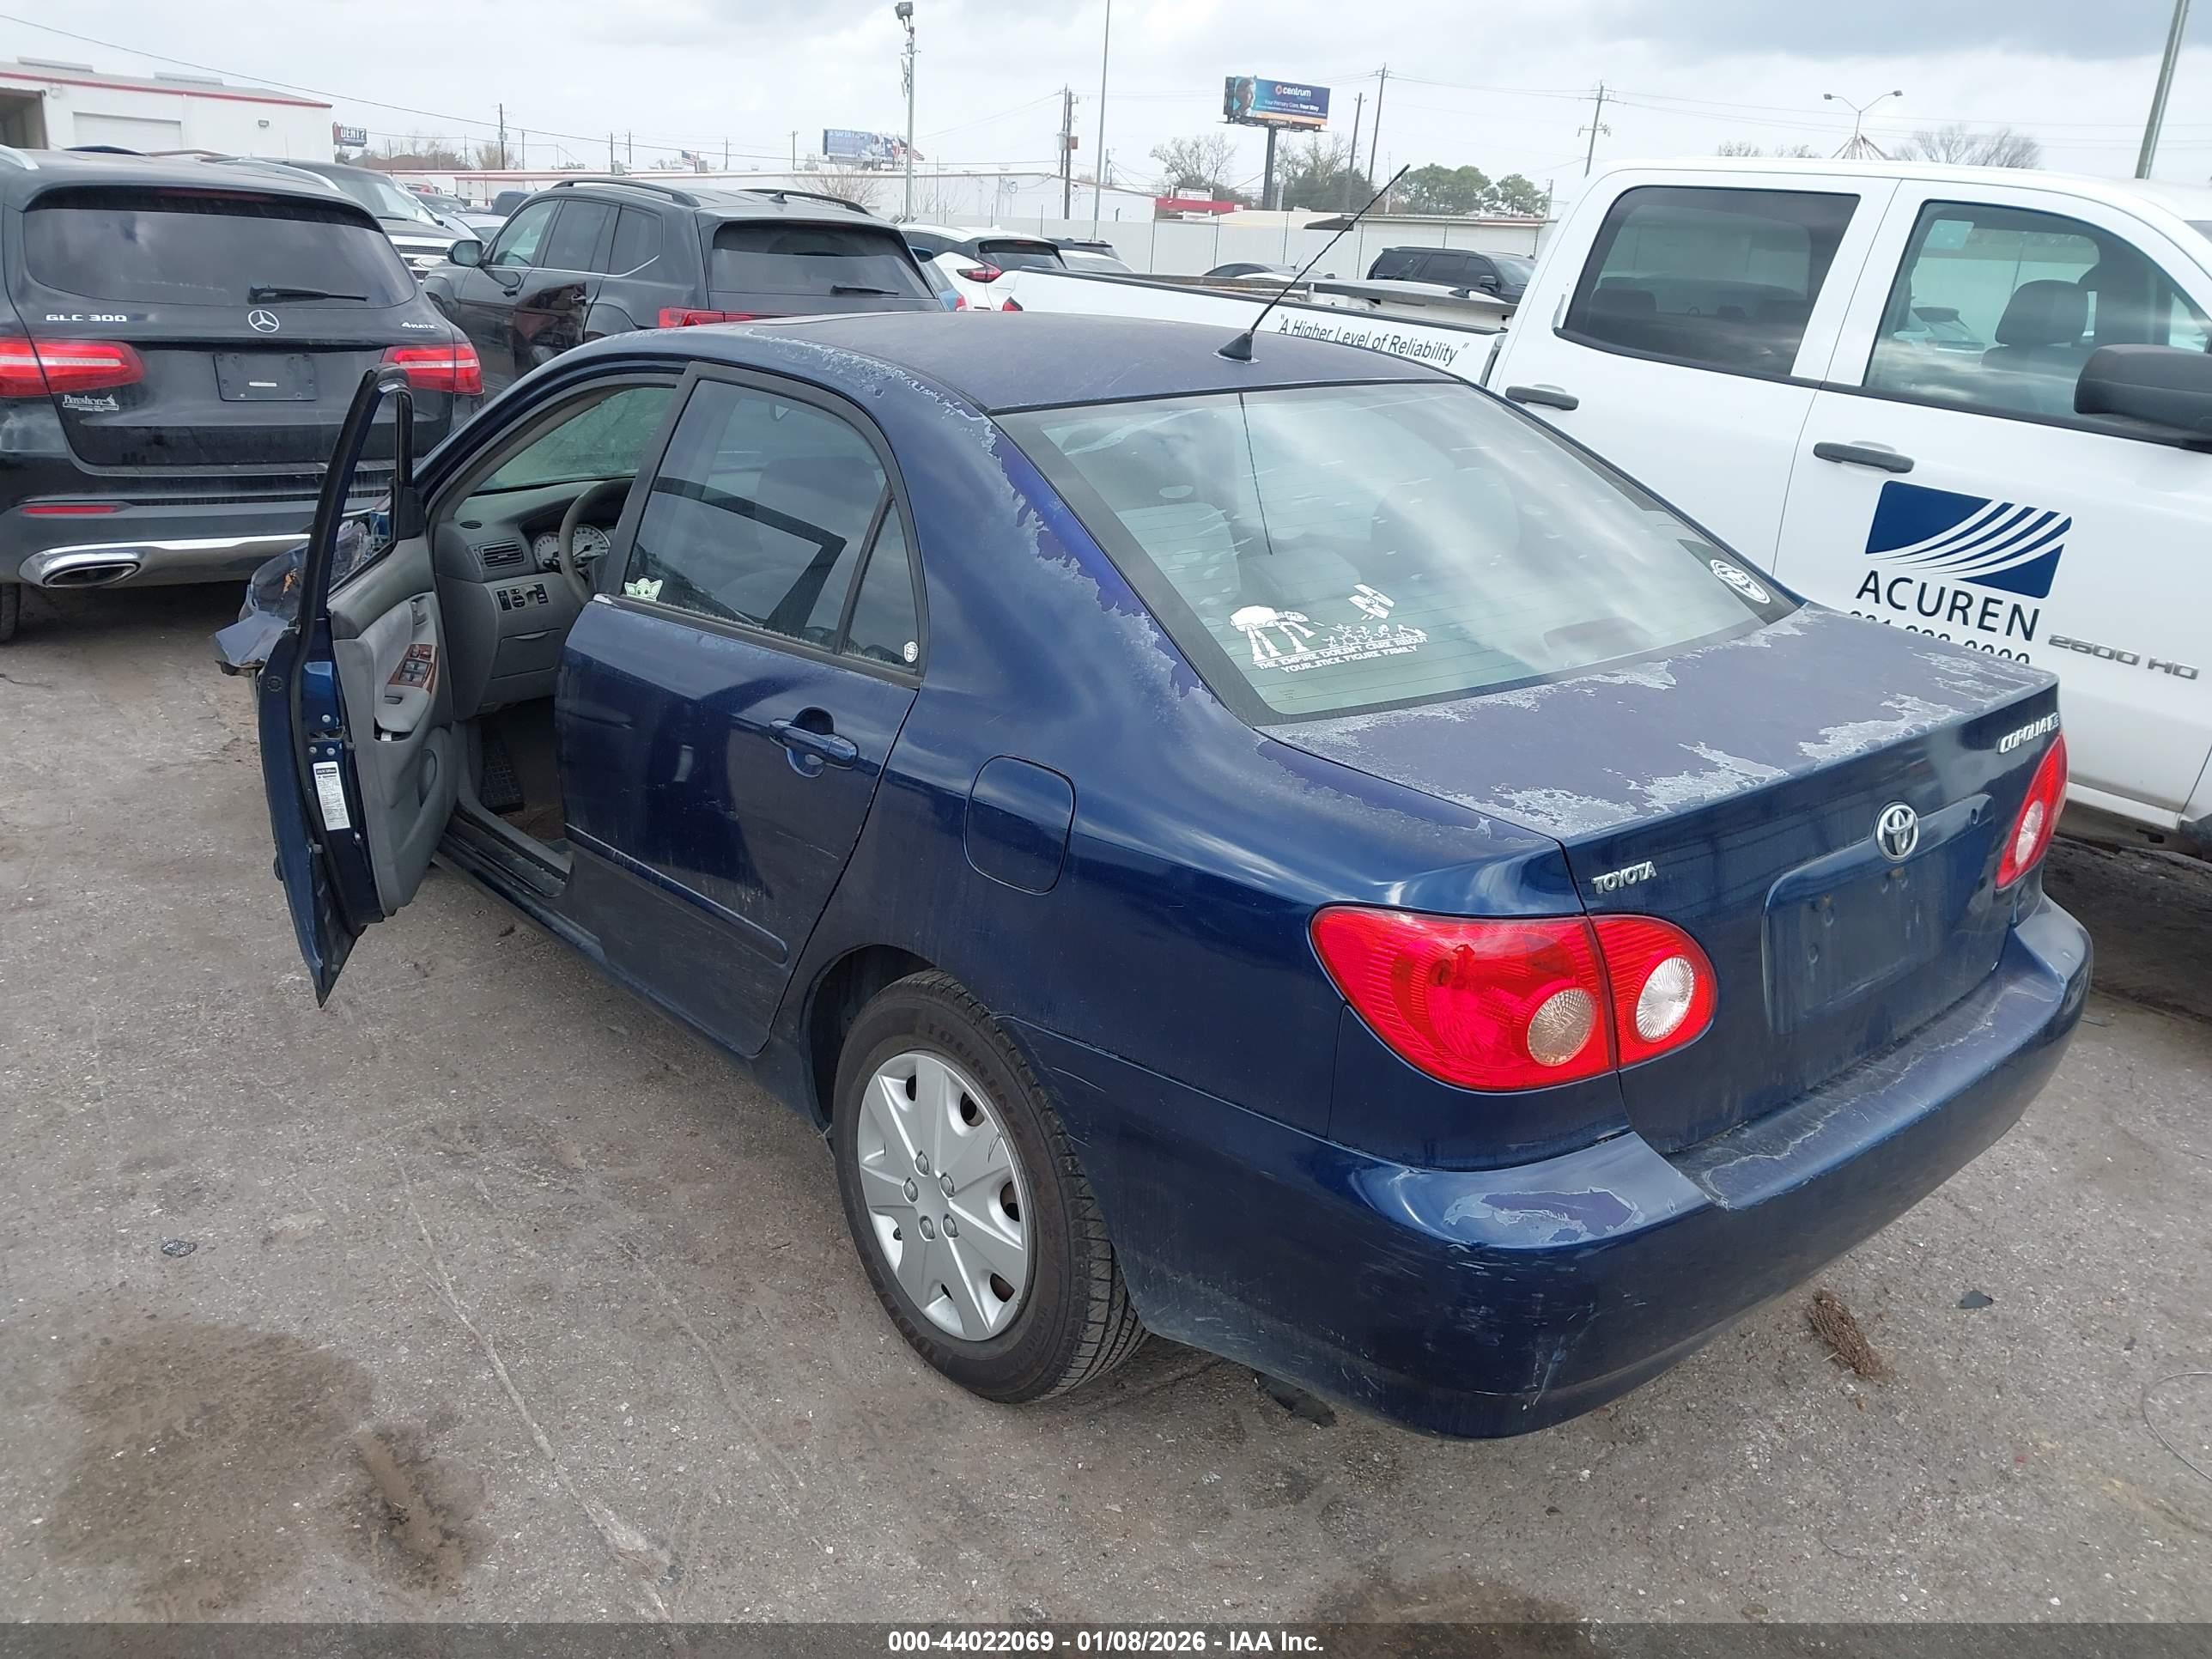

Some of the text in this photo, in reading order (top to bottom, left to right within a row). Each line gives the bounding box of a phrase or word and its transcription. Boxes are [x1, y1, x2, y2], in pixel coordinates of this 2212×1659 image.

[1283, 86, 1311, 97] centrum
[1291, 319, 1334, 340] Higher
[1334, 325, 1371, 348] Level
[1371, 333, 1389, 352] of
[1856, 569, 2040, 641] ACUREN
[1256, 660, 1279, 670] THE
[1278, 653, 1320, 665] EMPIRE
[1365, 641, 1394, 651] CARE
[1393, 636, 1428, 647] ABOUT
[1280, 645, 1418, 673] YOUR STICK FIGURE FAMILY
[2048, 633, 2141, 666] 2500
[2147, 656, 2199, 680] HD
[1997, 716, 2047, 754] COROLLA
[1591, 860, 1657, 894] TOYOTA
